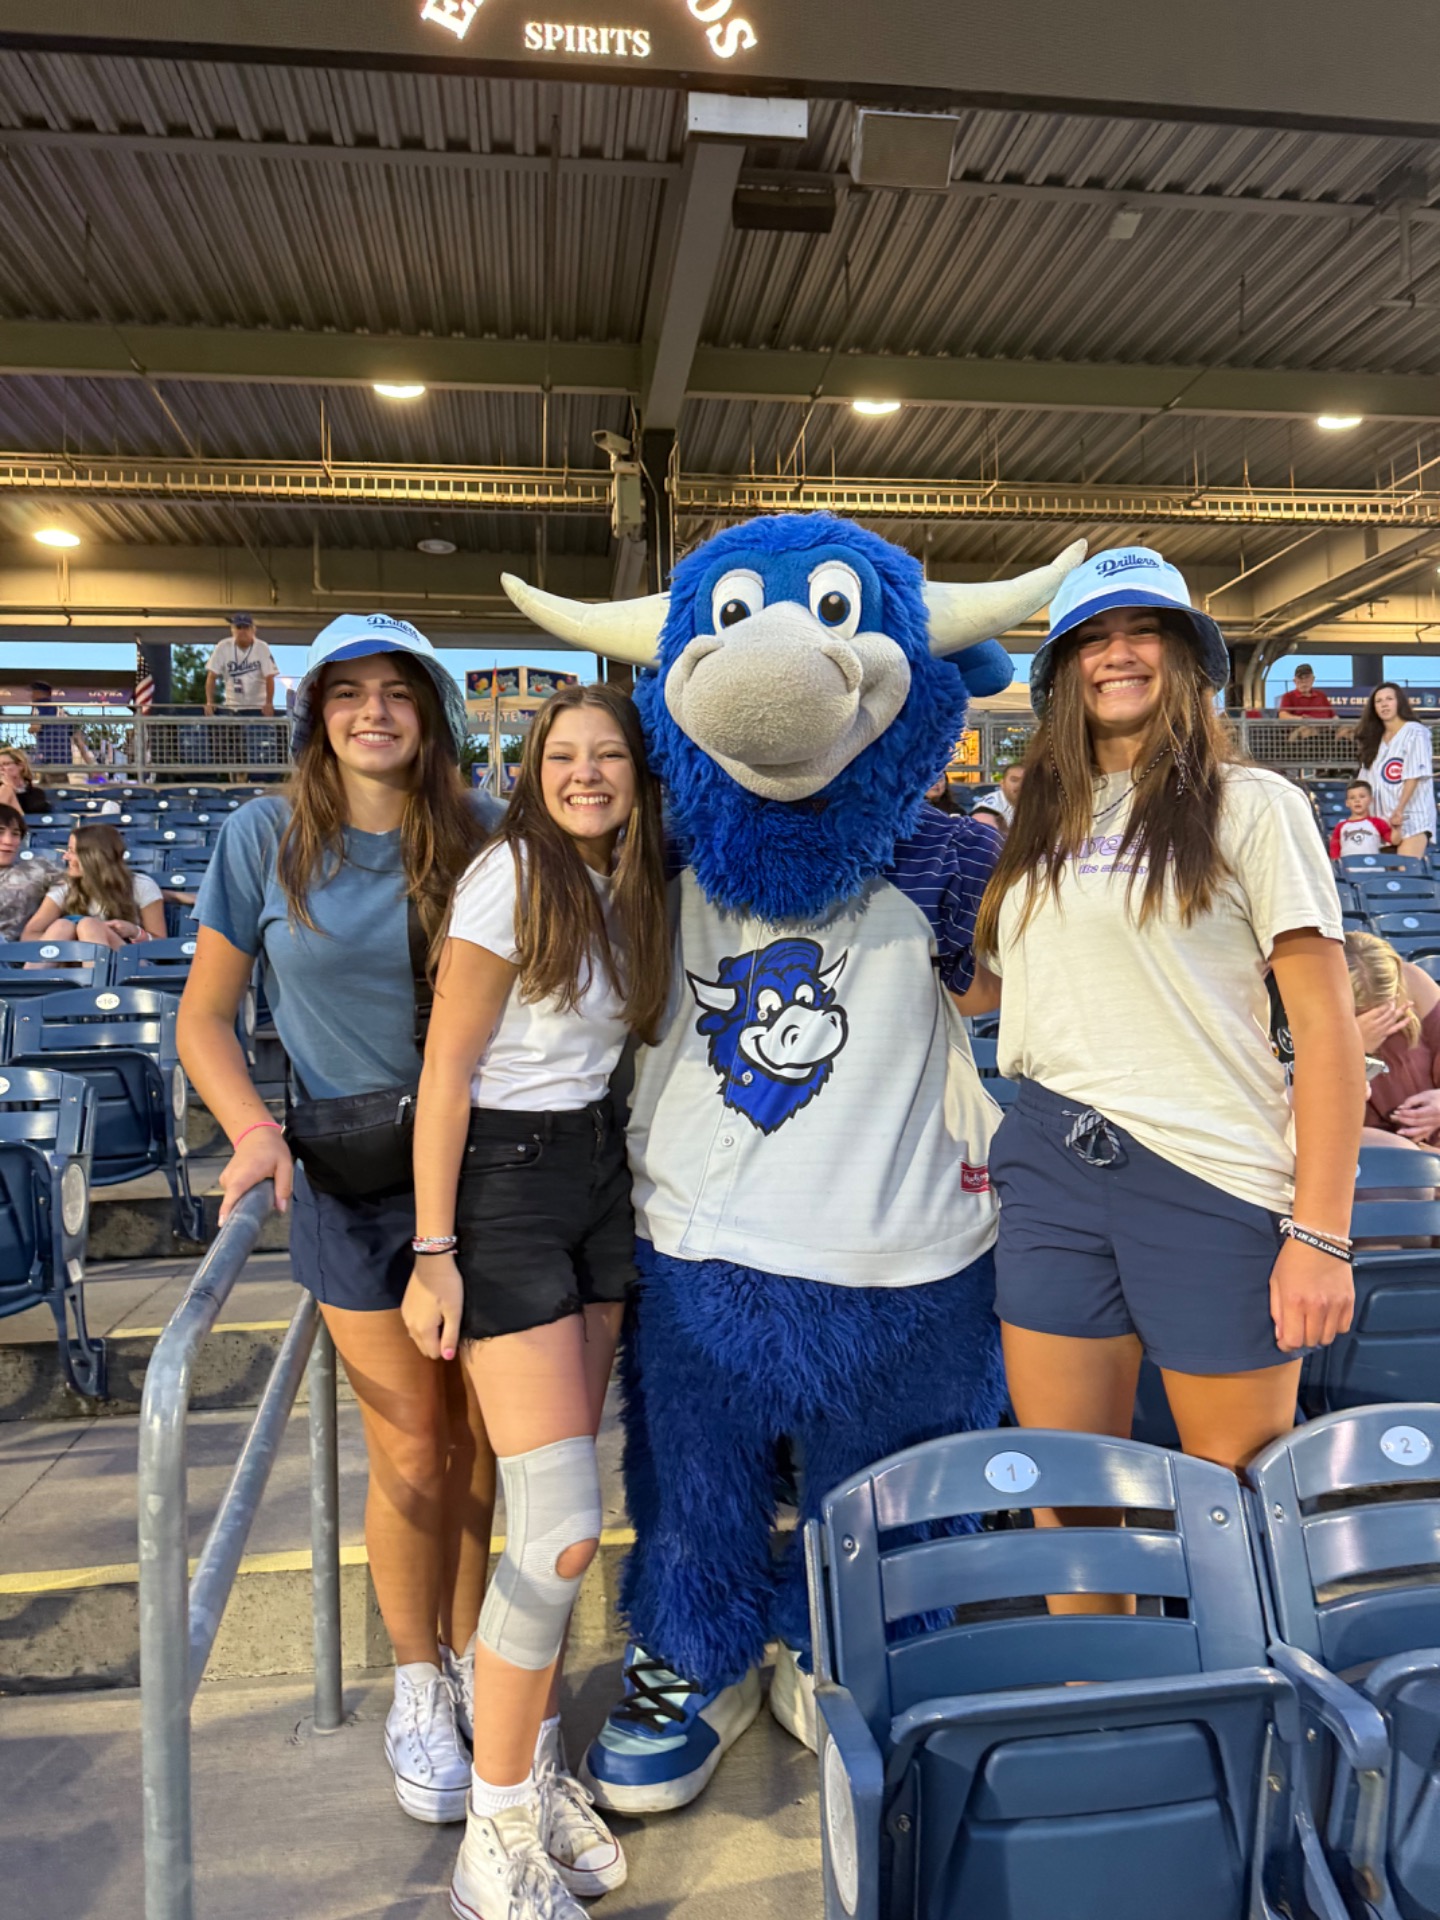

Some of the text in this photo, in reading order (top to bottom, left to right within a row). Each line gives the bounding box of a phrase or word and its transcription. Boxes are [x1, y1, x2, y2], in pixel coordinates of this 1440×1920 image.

[524, 21, 651, 58] SPIRITS
[1096, 555, 1158, 576] Drillers
[88, 690, 124, 698] ULTRA
[1318, 1241, 1351, 1260] PROPERTY
[1400, 1437, 1413, 1454] 2
[1006, 1463, 1016, 1482] 1
